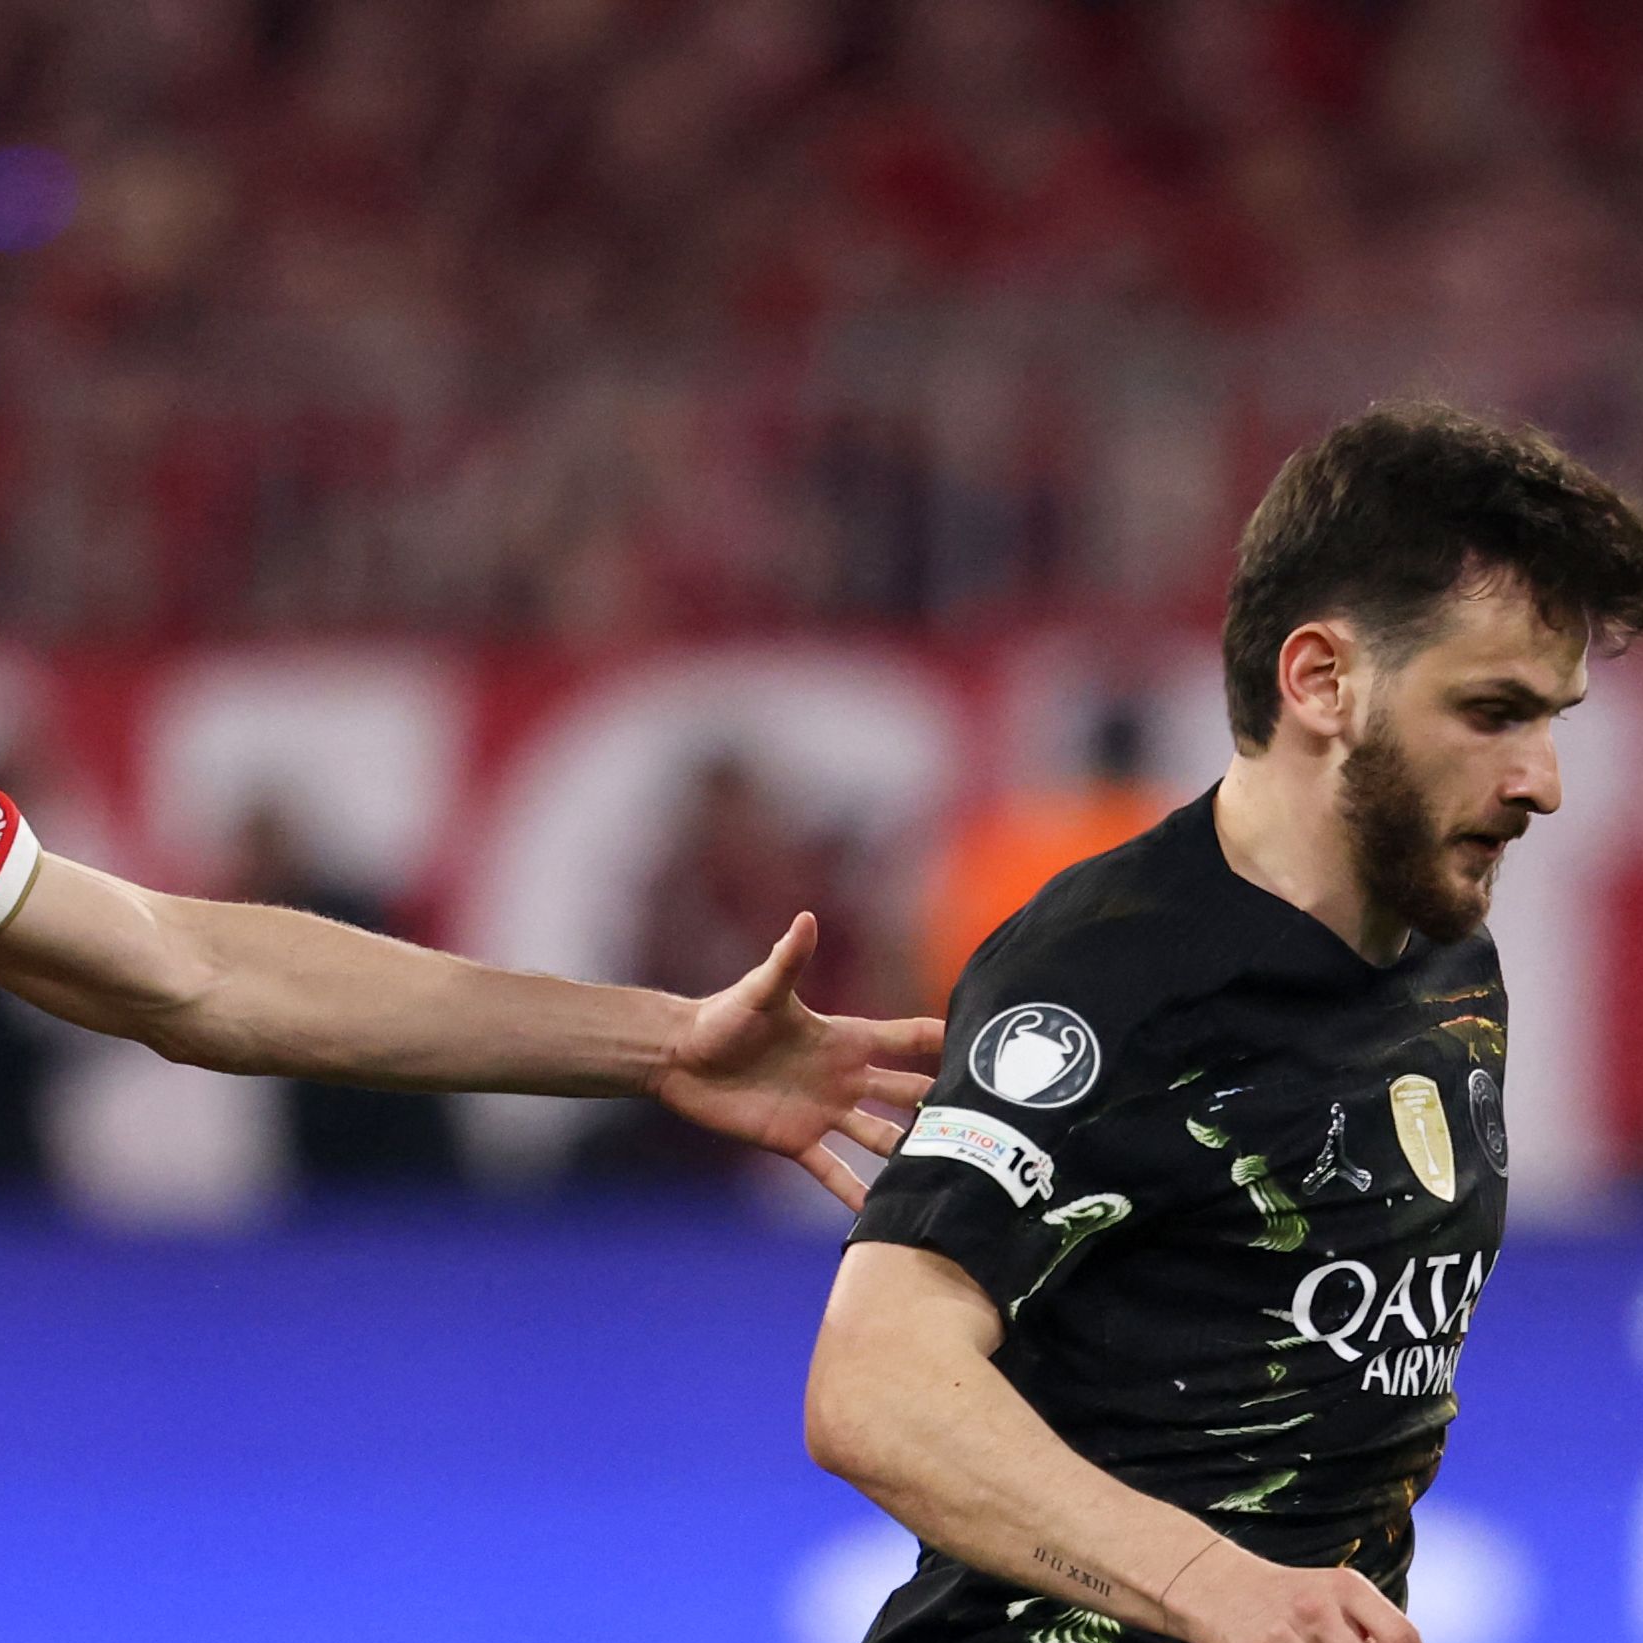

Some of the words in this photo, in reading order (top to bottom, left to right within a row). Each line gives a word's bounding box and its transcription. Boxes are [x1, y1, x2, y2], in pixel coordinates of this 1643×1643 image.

[1008, 1147, 1039, 1188] 10
[1292, 1250, 1500, 1362] QATA
[1361, 1342, 1464, 1396] AIRWA
